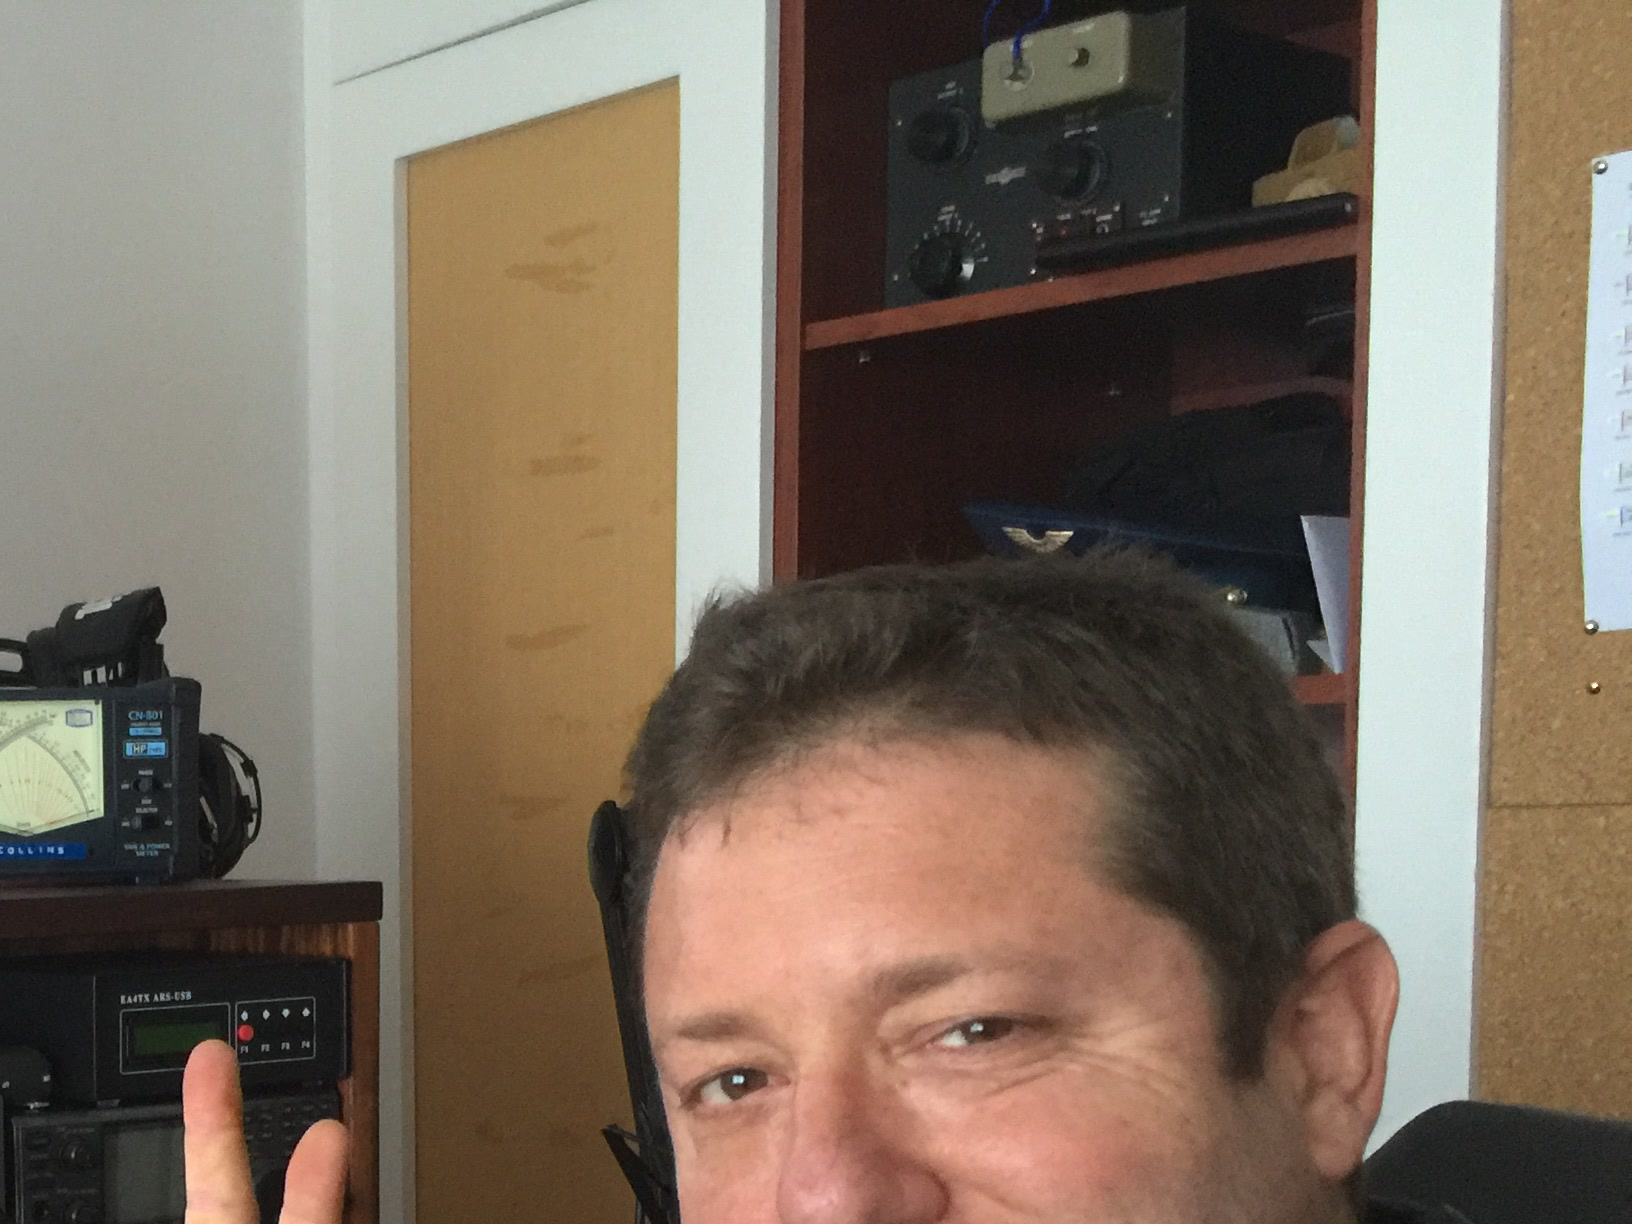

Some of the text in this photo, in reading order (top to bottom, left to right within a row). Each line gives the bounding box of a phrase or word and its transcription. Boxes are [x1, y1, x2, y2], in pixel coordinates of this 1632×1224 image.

[127, 710, 163, 721] CN-801
[120, 990, 192, 1005] EA4TX ARS-USB
